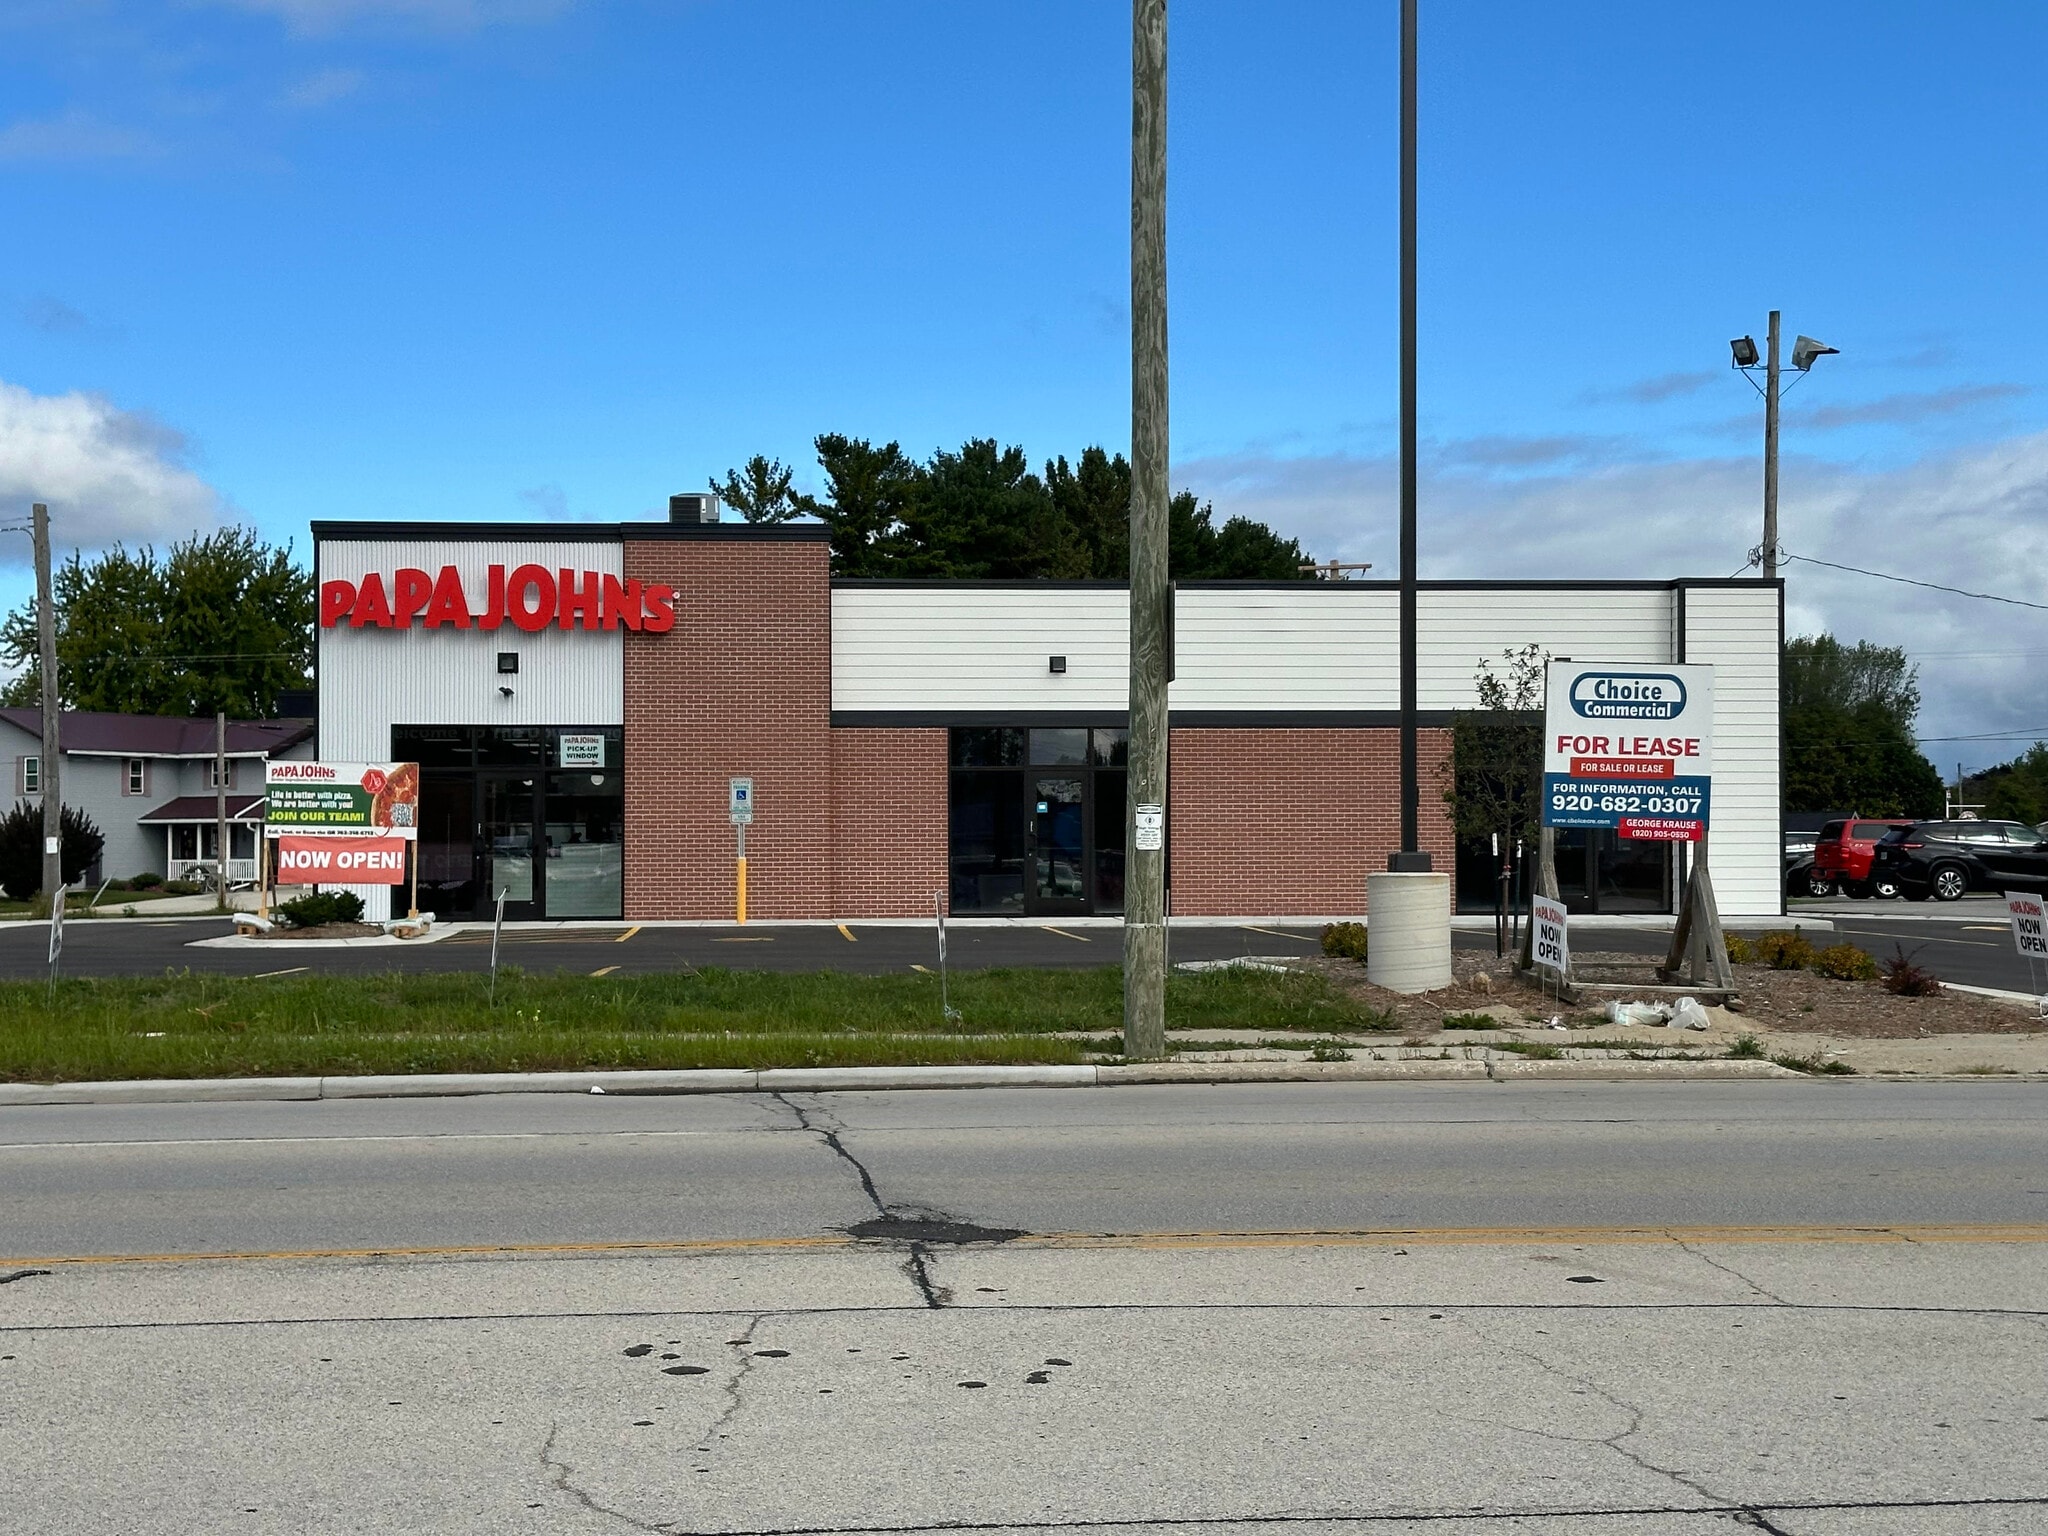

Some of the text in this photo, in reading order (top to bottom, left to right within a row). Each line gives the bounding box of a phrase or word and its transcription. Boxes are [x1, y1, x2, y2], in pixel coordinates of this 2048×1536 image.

[321, 564, 675, 632] PAPA JOHNS
[1594, 680, 1662, 699] Choice
[1585, 702, 1671, 717] Commercial
[1557, 735, 1700, 756] FOR LEASE
[271, 765, 336, 778] PAPA JOHNS
[1581, 763, 1664, 774] FOR SALE OR LEASE
[271, 791, 284, 799] Life
[285, 791, 293, 799] is
[293, 791, 316, 799] better
[334, 792, 353, 800] pizza.
[1553, 784, 1701, 796] FOR INFORMATION, CALL
[271, 800, 282, 808] We
[298, 800, 320, 808] better
[338, 801, 353, 809] you!
[1552, 795, 1701, 813] 920-682-0307
[268, 812, 365, 821] JOIN OUR TEAM!
[1626, 819, 1697, 829] GEORGE KRAUSE
[1632, 830, 1652, 838] (920)
[281, 851, 332, 868] NOW
[336, 851, 403, 869] OPEN!
[2017, 918, 2041, 934] NOW
[1541, 924, 1561, 944] NOW
[2020, 935, 2047, 953] OPEN
[1538, 941, 1561, 964] OPEN
